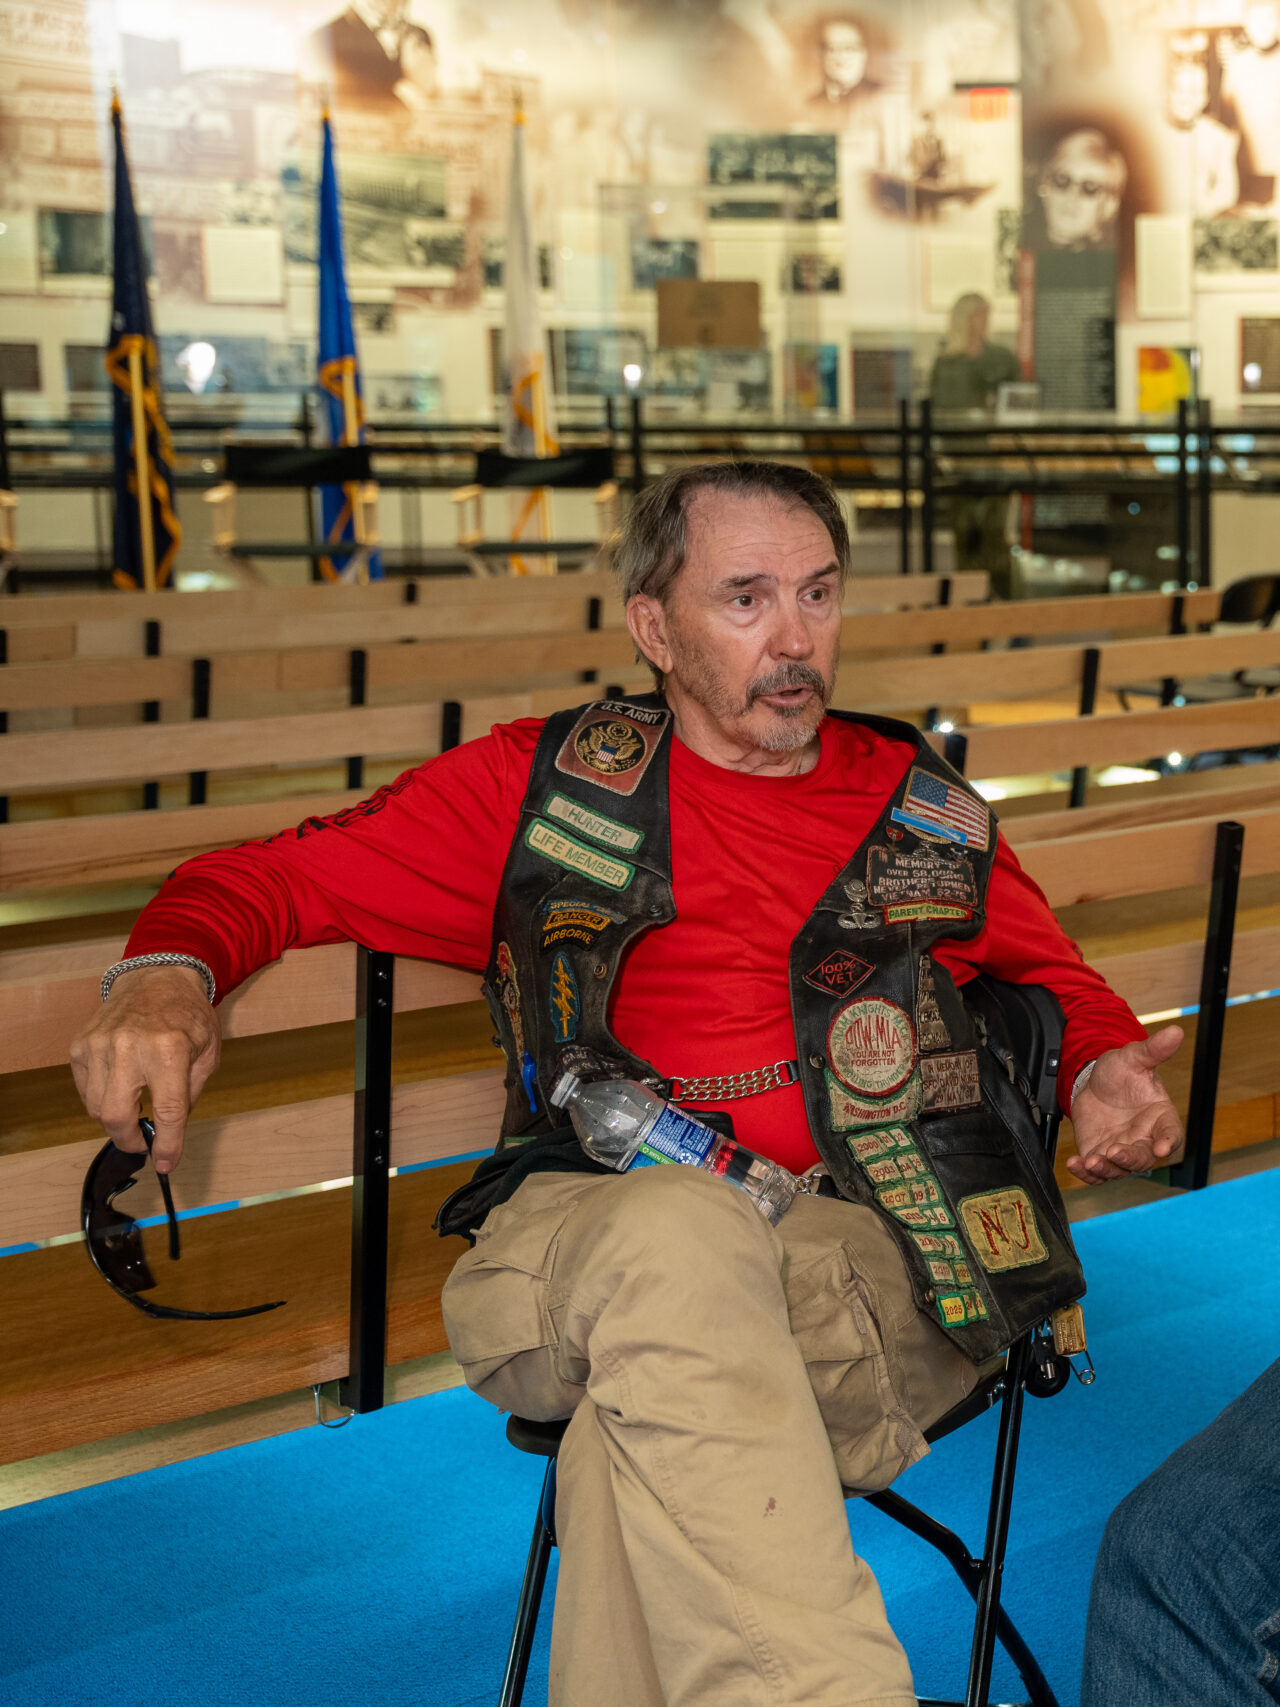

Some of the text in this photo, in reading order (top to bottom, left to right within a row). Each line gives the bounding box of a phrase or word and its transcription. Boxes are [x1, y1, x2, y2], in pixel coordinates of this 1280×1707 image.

[624, 708, 660, 725] ARMY
[567, 808, 622, 842] HUNTER
[532, 828, 624, 883] LIFE MEMBER
[895, 857, 940, 869] MEMORY
[886, 868, 909, 876] OVER
[553, 911, 602, 924] RANGER
[889, 905, 967, 919] PARENT CHAPTER
[544, 928, 594, 947] AIRBORNE
[821, 959, 856, 975] 100%
[825, 971, 854, 985] VET
[850, 1003, 891, 1018] KNIGHTS
[851, 1049, 896, 1058] YOU ARE NOT
[851, 1058, 896, 1067] FORGOTTEN
[843, 1102, 892, 1119] WASHINGTON
[883, 1193, 906, 1203] 2007
[973, 1200, 1030, 1256] NJ
[945, 1305, 963, 1316] 2025
